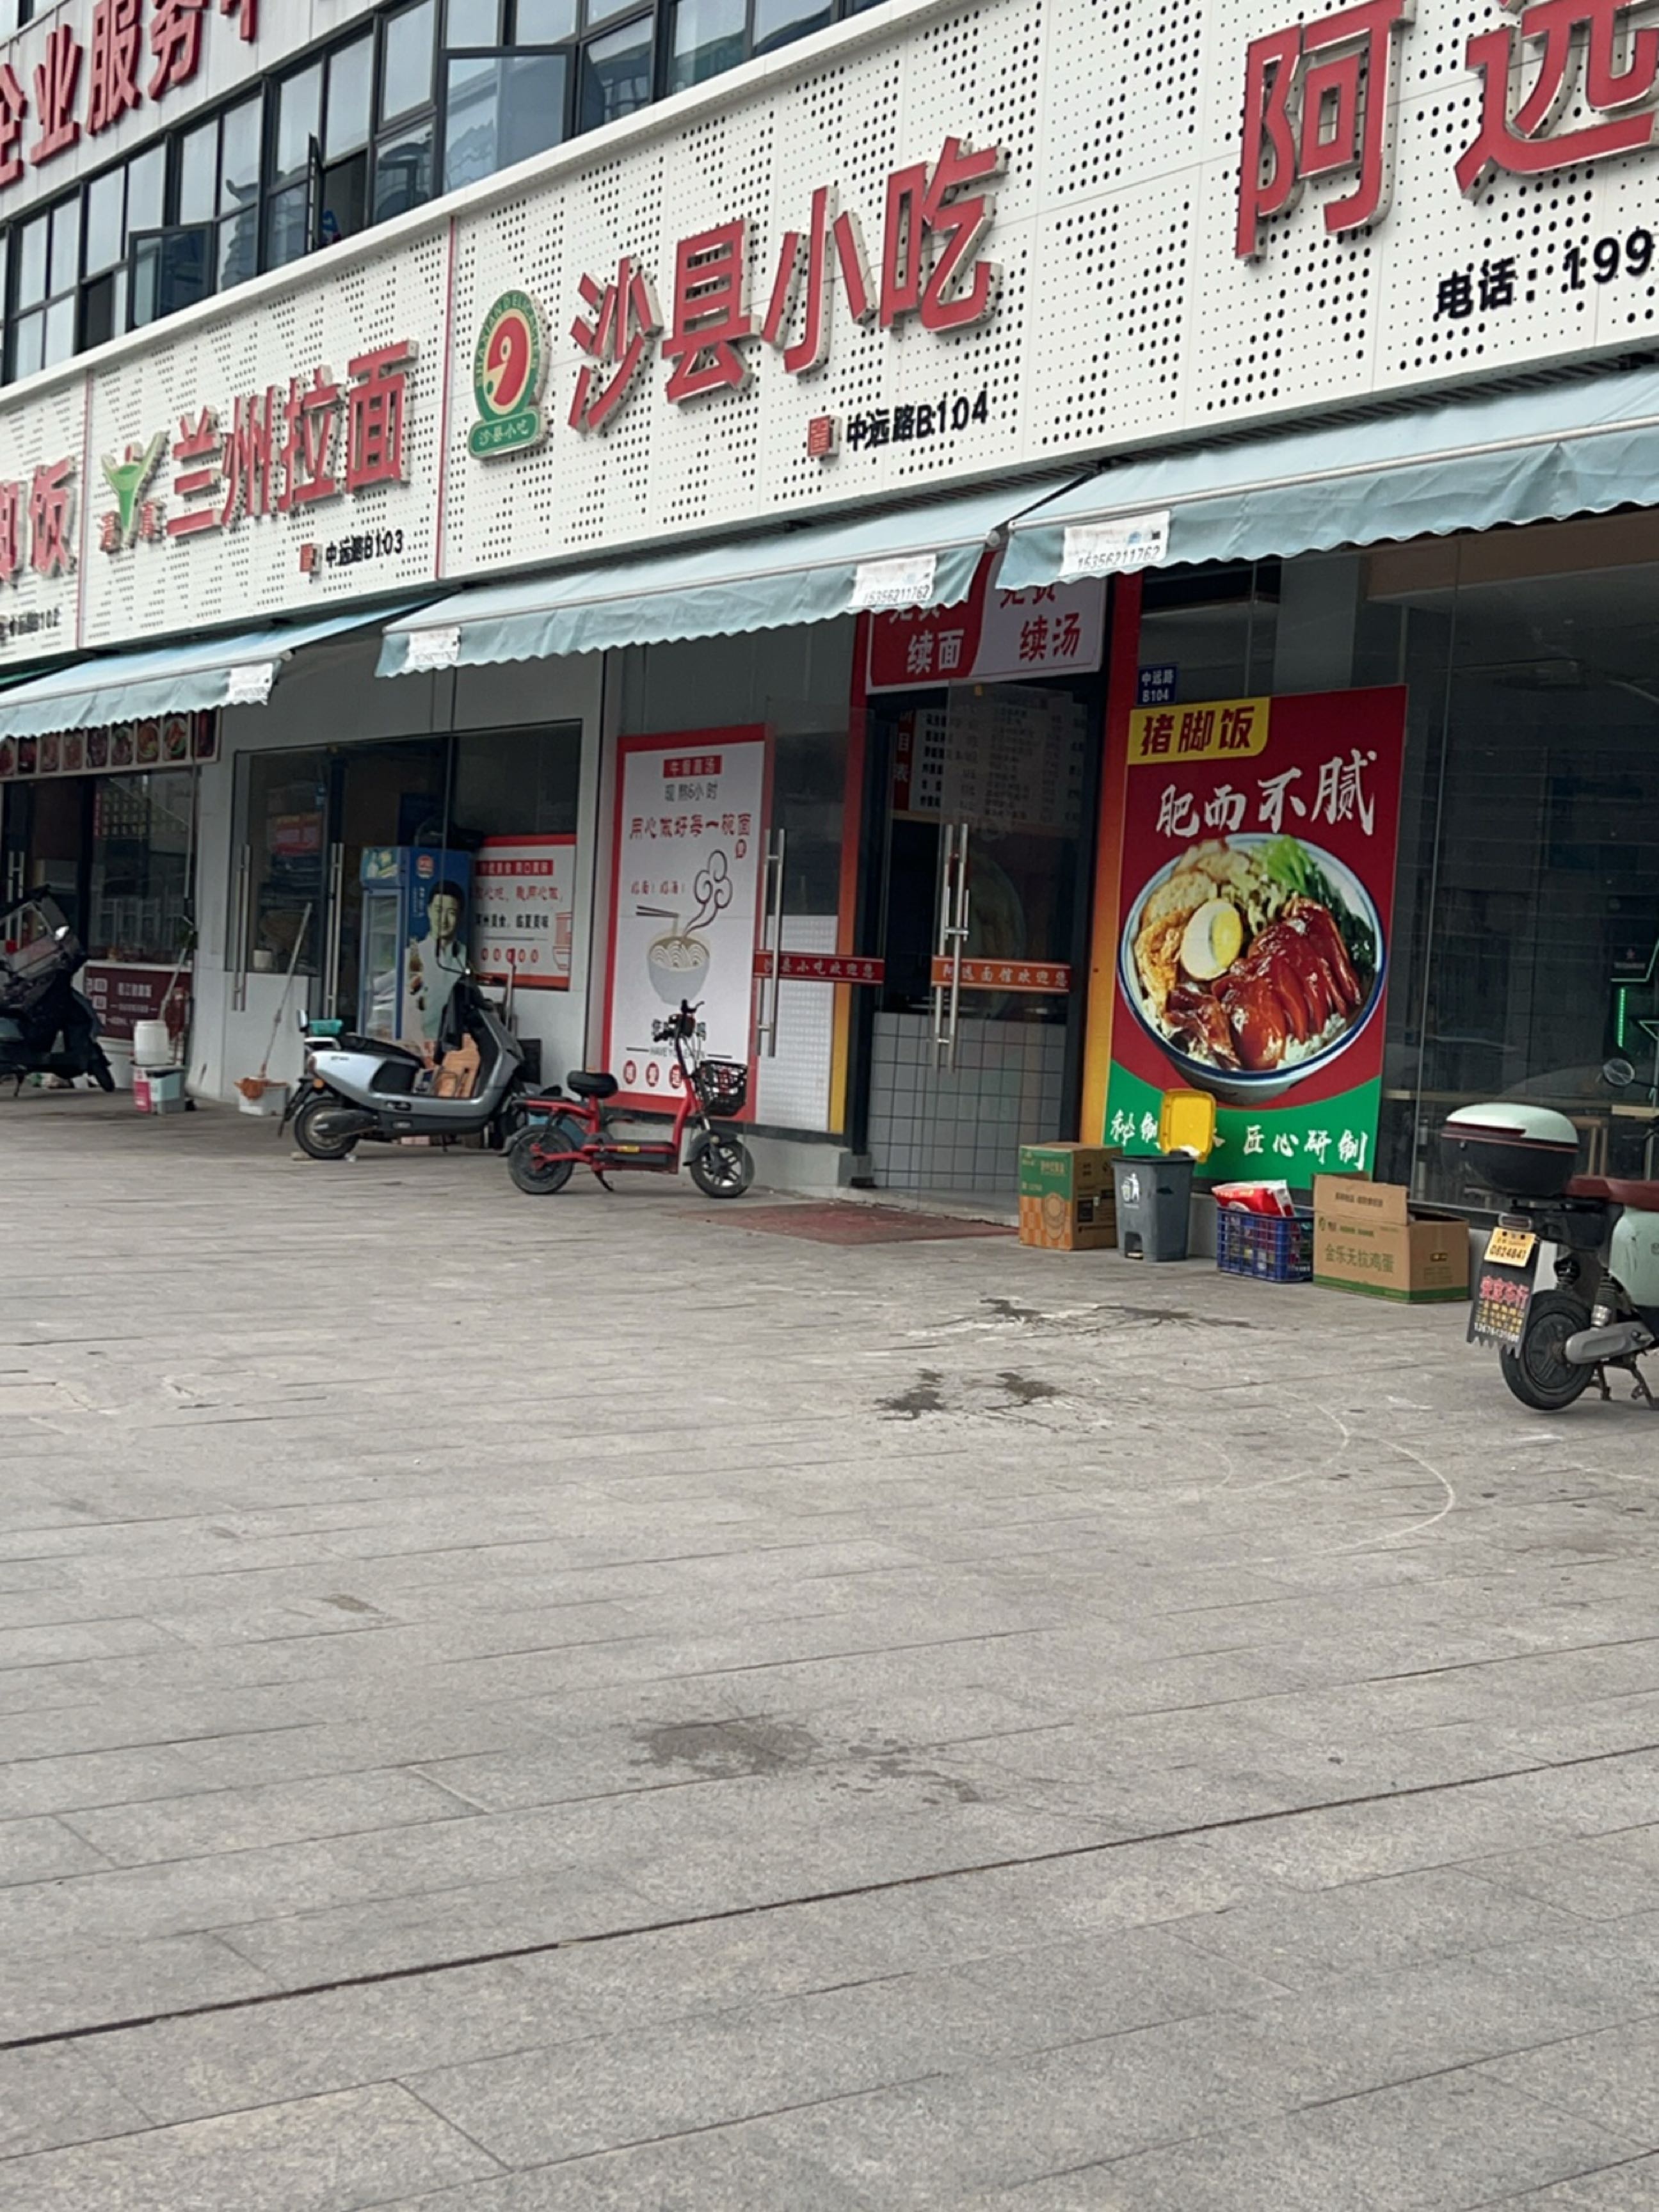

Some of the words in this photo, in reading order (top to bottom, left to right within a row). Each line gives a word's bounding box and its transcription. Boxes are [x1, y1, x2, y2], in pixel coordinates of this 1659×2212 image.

[0, 0, 257, 188] 企业服务
[1235, 0, 1659, 259] 阿远
[568, 136, 1005, 433] 沙县小吃
[166, 340, 419, 536] 兰州拉面
[847, 389, 989, 452] 中远路B104
[906, 627, 965, 673] 续面
[1019, 613, 1081, 662] 续汤
[1141, 669, 1174, 687] 中远路
[1142, 688, 1169, 703] B104
[1141, 705, 1256, 757] 猪脚饭
[1156, 748, 1377, 838] 肥而不腻
[1244, 1124, 1370, 1171] 匠心研制
